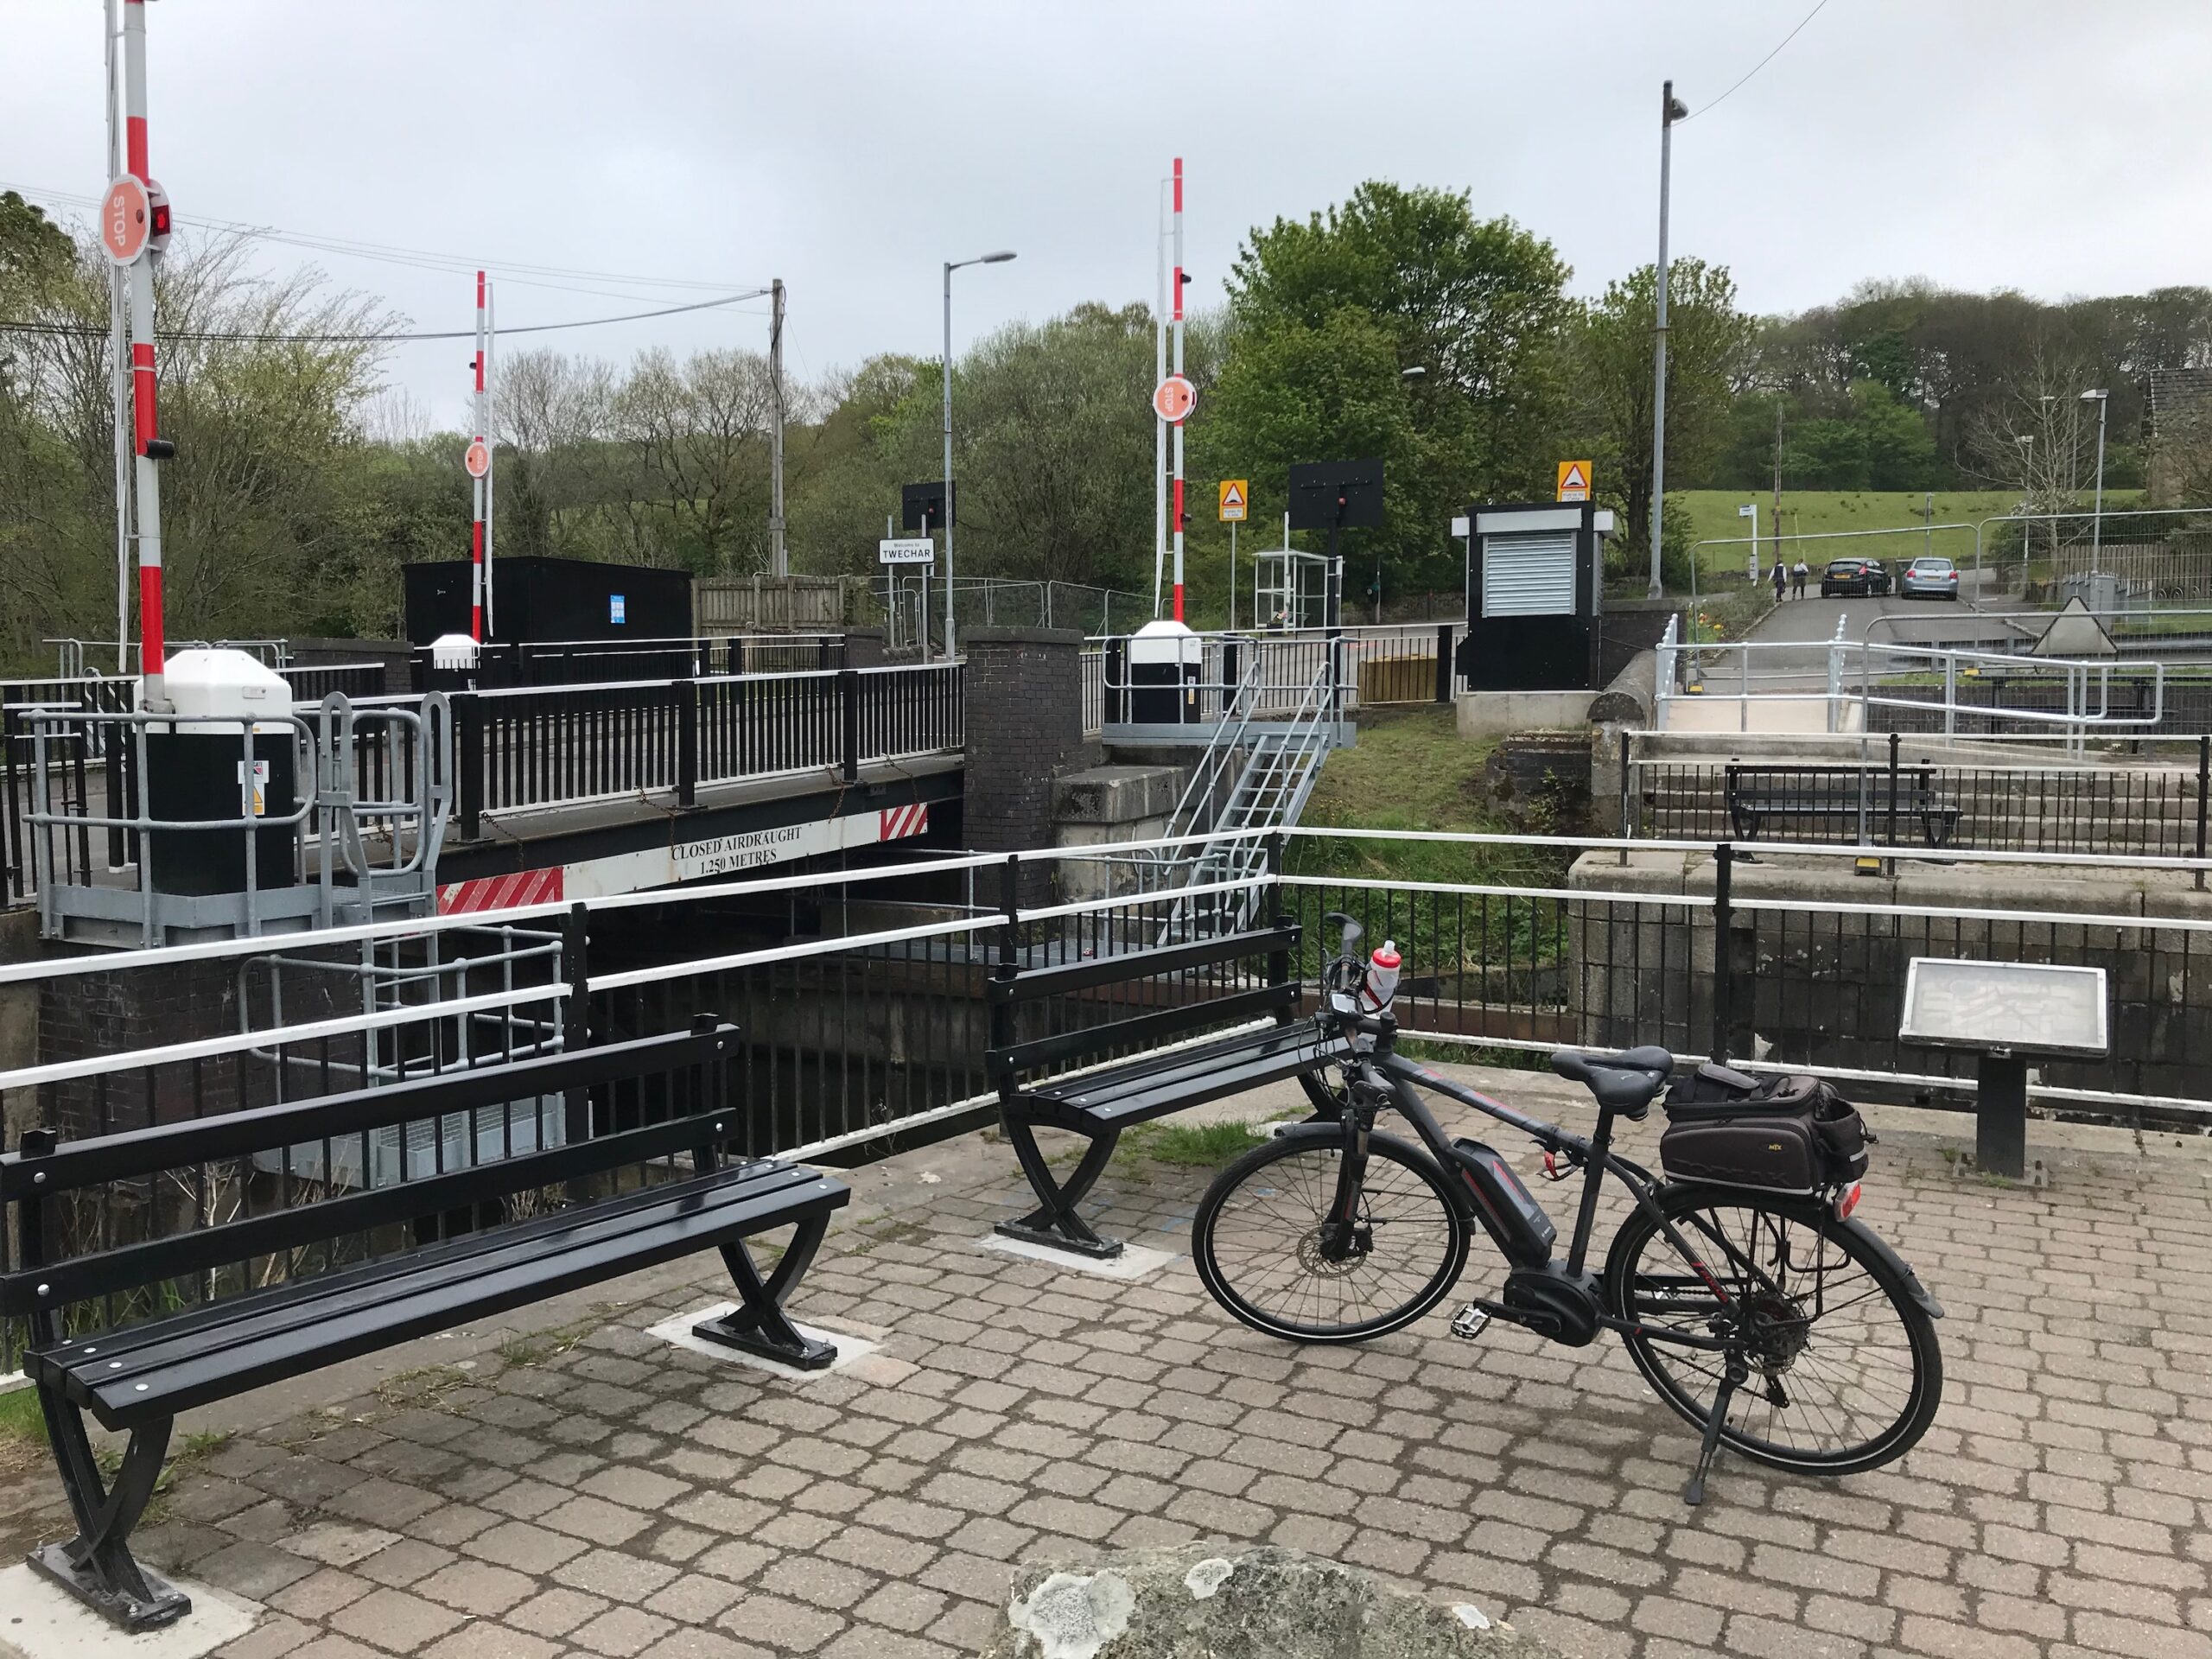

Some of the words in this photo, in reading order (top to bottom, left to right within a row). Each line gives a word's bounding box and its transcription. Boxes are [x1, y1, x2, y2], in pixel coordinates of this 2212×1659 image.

[113, 195, 126, 246] STOP
[1164, 386, 1174, 412] STOP
[882, 549, 931, 559] TWECHAR
[671, 837, 721, 861] CLOSED
[723, 826, 803, 852] AIRDRAUGHT
[700, 855, 727, 874] 1.250
[728, 848, 778, 868] METRES
